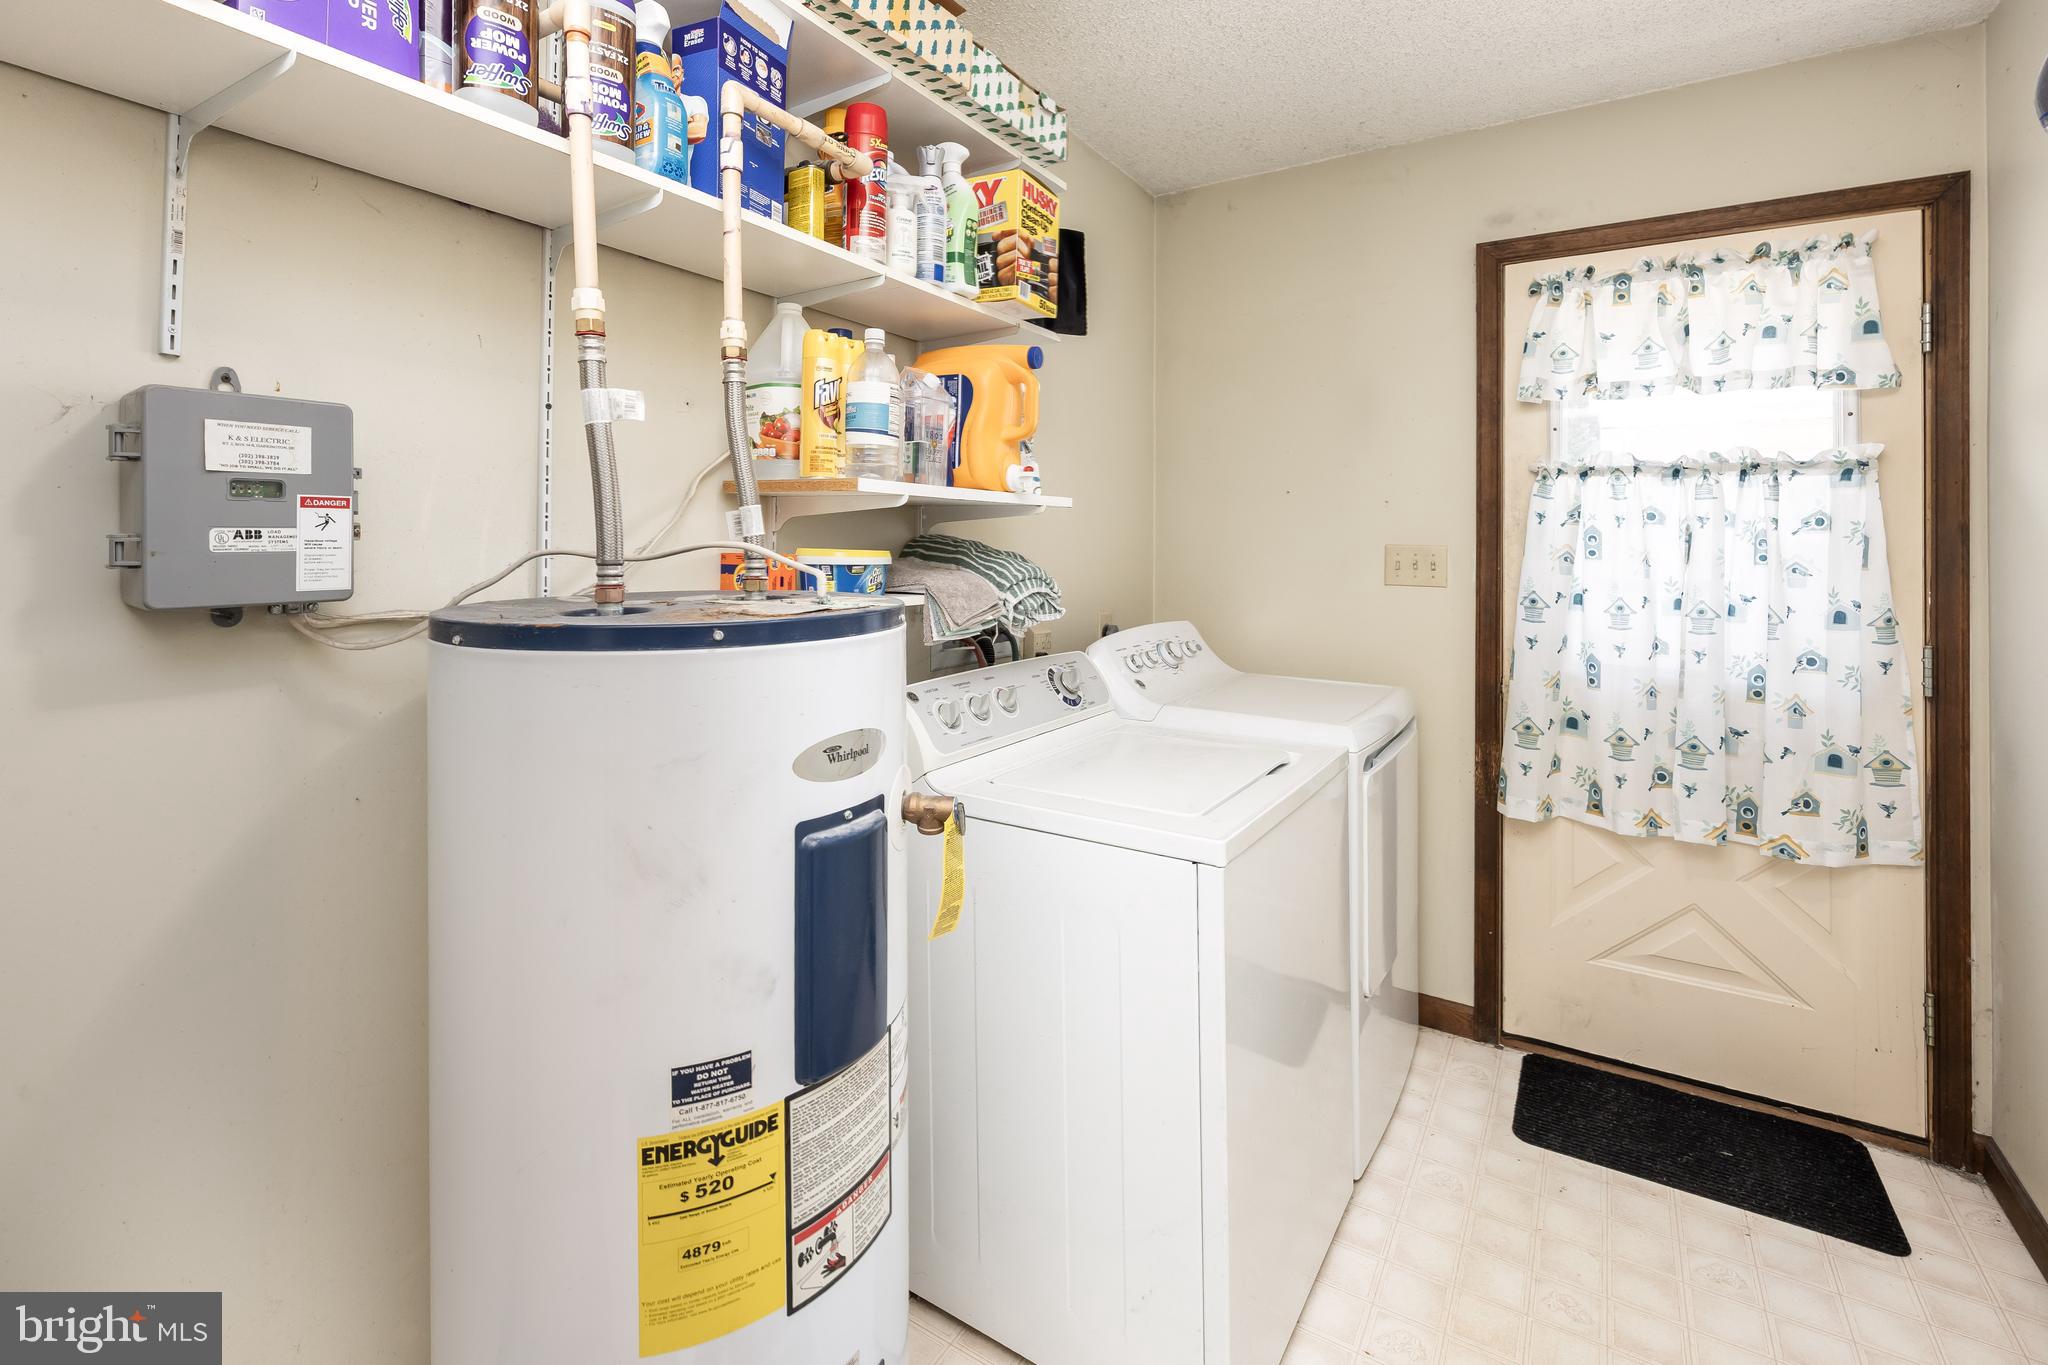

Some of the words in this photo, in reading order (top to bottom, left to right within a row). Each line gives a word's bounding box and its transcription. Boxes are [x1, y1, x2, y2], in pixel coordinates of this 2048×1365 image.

[482, 9, 515, 27] WOOD
[480, 27, 520, 50] MOP
[684, 37, 705, 48] Eraser
[470, 37, 527, 64] POWER
[466, 62, 532, 95] Swiffer
[1022, 178, 1058, 218] HUSKY
[1021, 199, 1054, 226] Contractor
[1021, 208, 1049, 234] Clean-Up
[1021, 222, 1038, 237] Bags
[250, 436, 290, 445] ELECTRIC
[313, 499, 347, 507] DANGER
[232, 529, 263, 540] ABB
[827, 743, 869, 765] Whirlpool
[680, 1066, 695, 1076] YOU
[695, 1063, 714, 1073] HAVE
[721, 1053, 751, 1067] PROBLEM
[696, 1072, 709, 1081] DO
[710, 1067, 729, 1078] NOT
[690, 1086, 711, 1096] WATER
[712, 1080, 735, 1091] HEATER
[693, 1078, 717, 1089] RETURN
[718, 1074, 732, 1083] THIS
[681, 1097, 693, 1105] THE
[694, 1092, 712, 1102] PLACE
[679, 1106, 693, 1116] Call
[641, 1112, 779, 1167] ENERGYGUIDE
[658, 1179, 692, 1191] Estimated
[693, 1170, 714, 1184] Yearly
[715, 1163, 747, 1179] Operating
[747, 1156, 763, 1167] Cost
[679, 1190, 690, 1203] $
[695, 1175, 735, 1200] 520
[841, 1174, 874, 1209] DANGER
[681, 1240, 721, 1260] 4879
[656, 1297, 670, 1305] cost
[682, 1287, 705, 1300] depend
